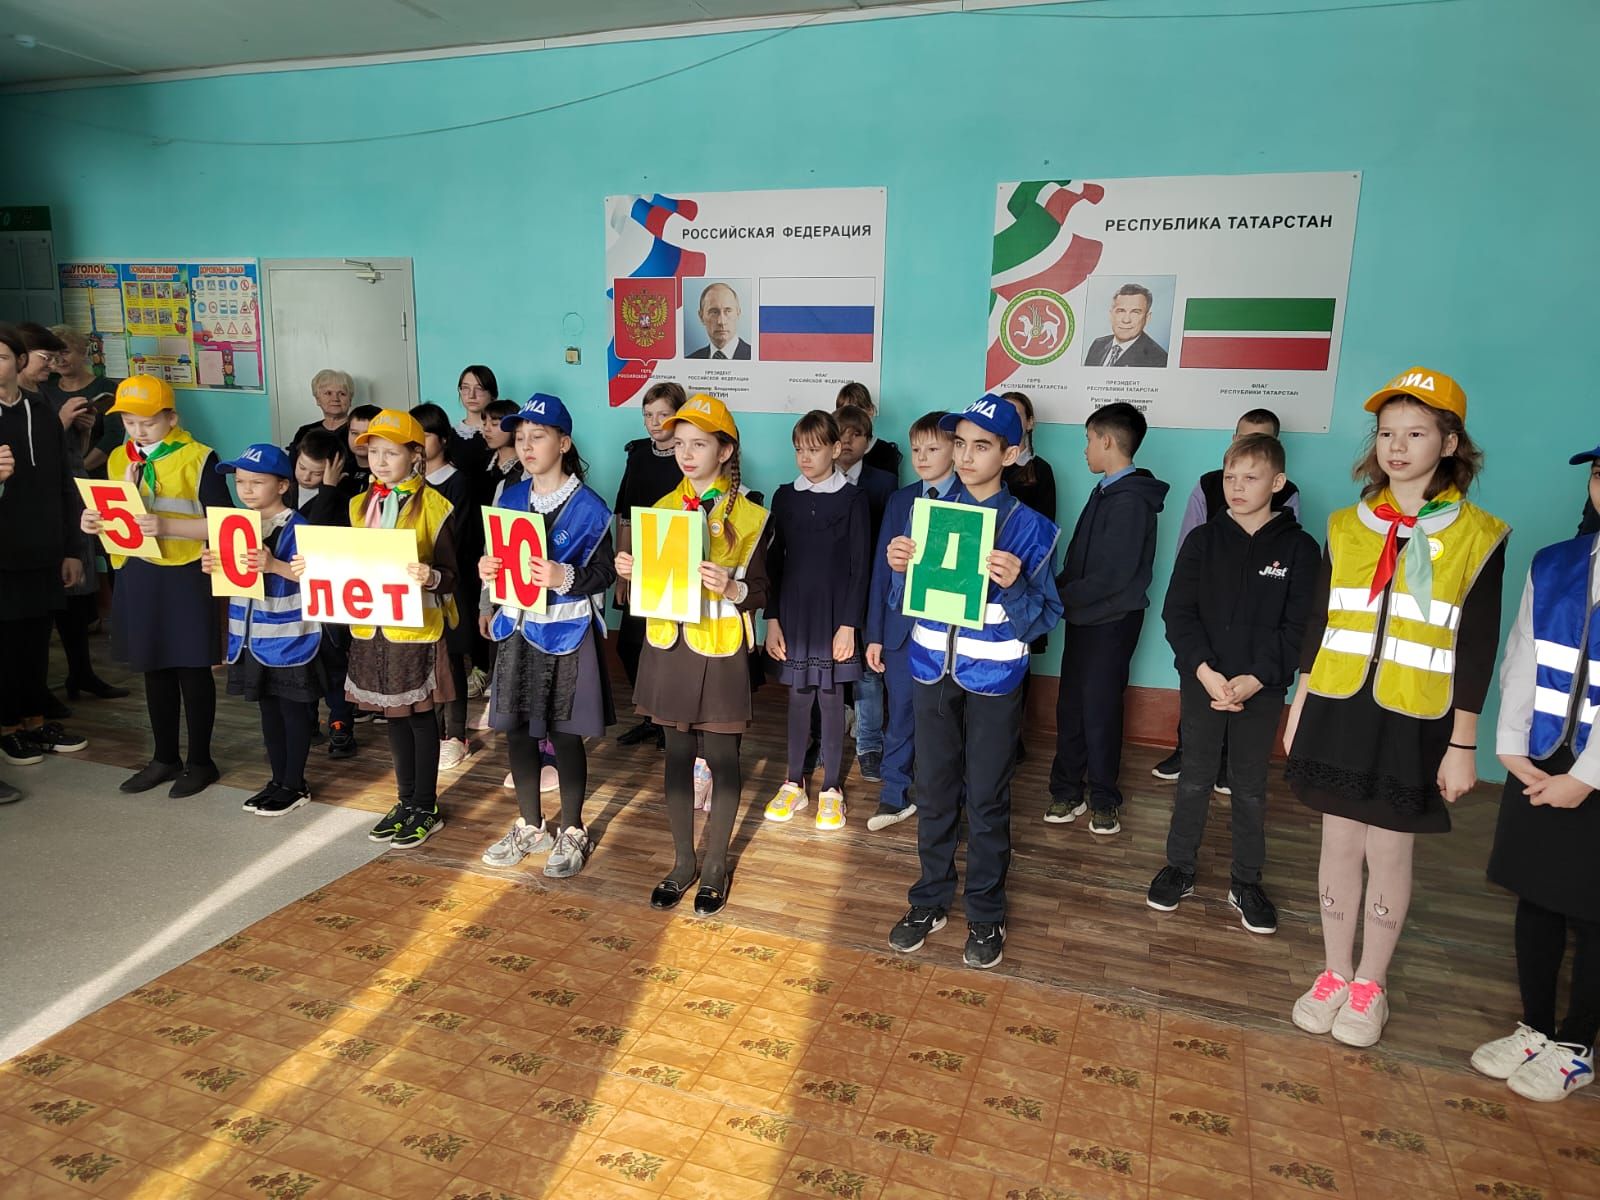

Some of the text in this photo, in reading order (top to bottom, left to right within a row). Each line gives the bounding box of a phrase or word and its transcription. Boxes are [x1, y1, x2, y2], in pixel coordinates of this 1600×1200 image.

[682, 224, 872, 240] РОССИЙСКАЯ ФЕДЕРАЦИЯ
[1105, 214, 1333, 232] РЕСПУБЛИКА ТАТАРСТАН
[72, 264, 105, 274] УГОЛОК
[91, 486, 144, 550] 5
[488, 514, 543, 607] Ю
[641, 513, 689, 615] И
[910, 506, 984, 622] Д
[307, 578, 409, 620] лет
